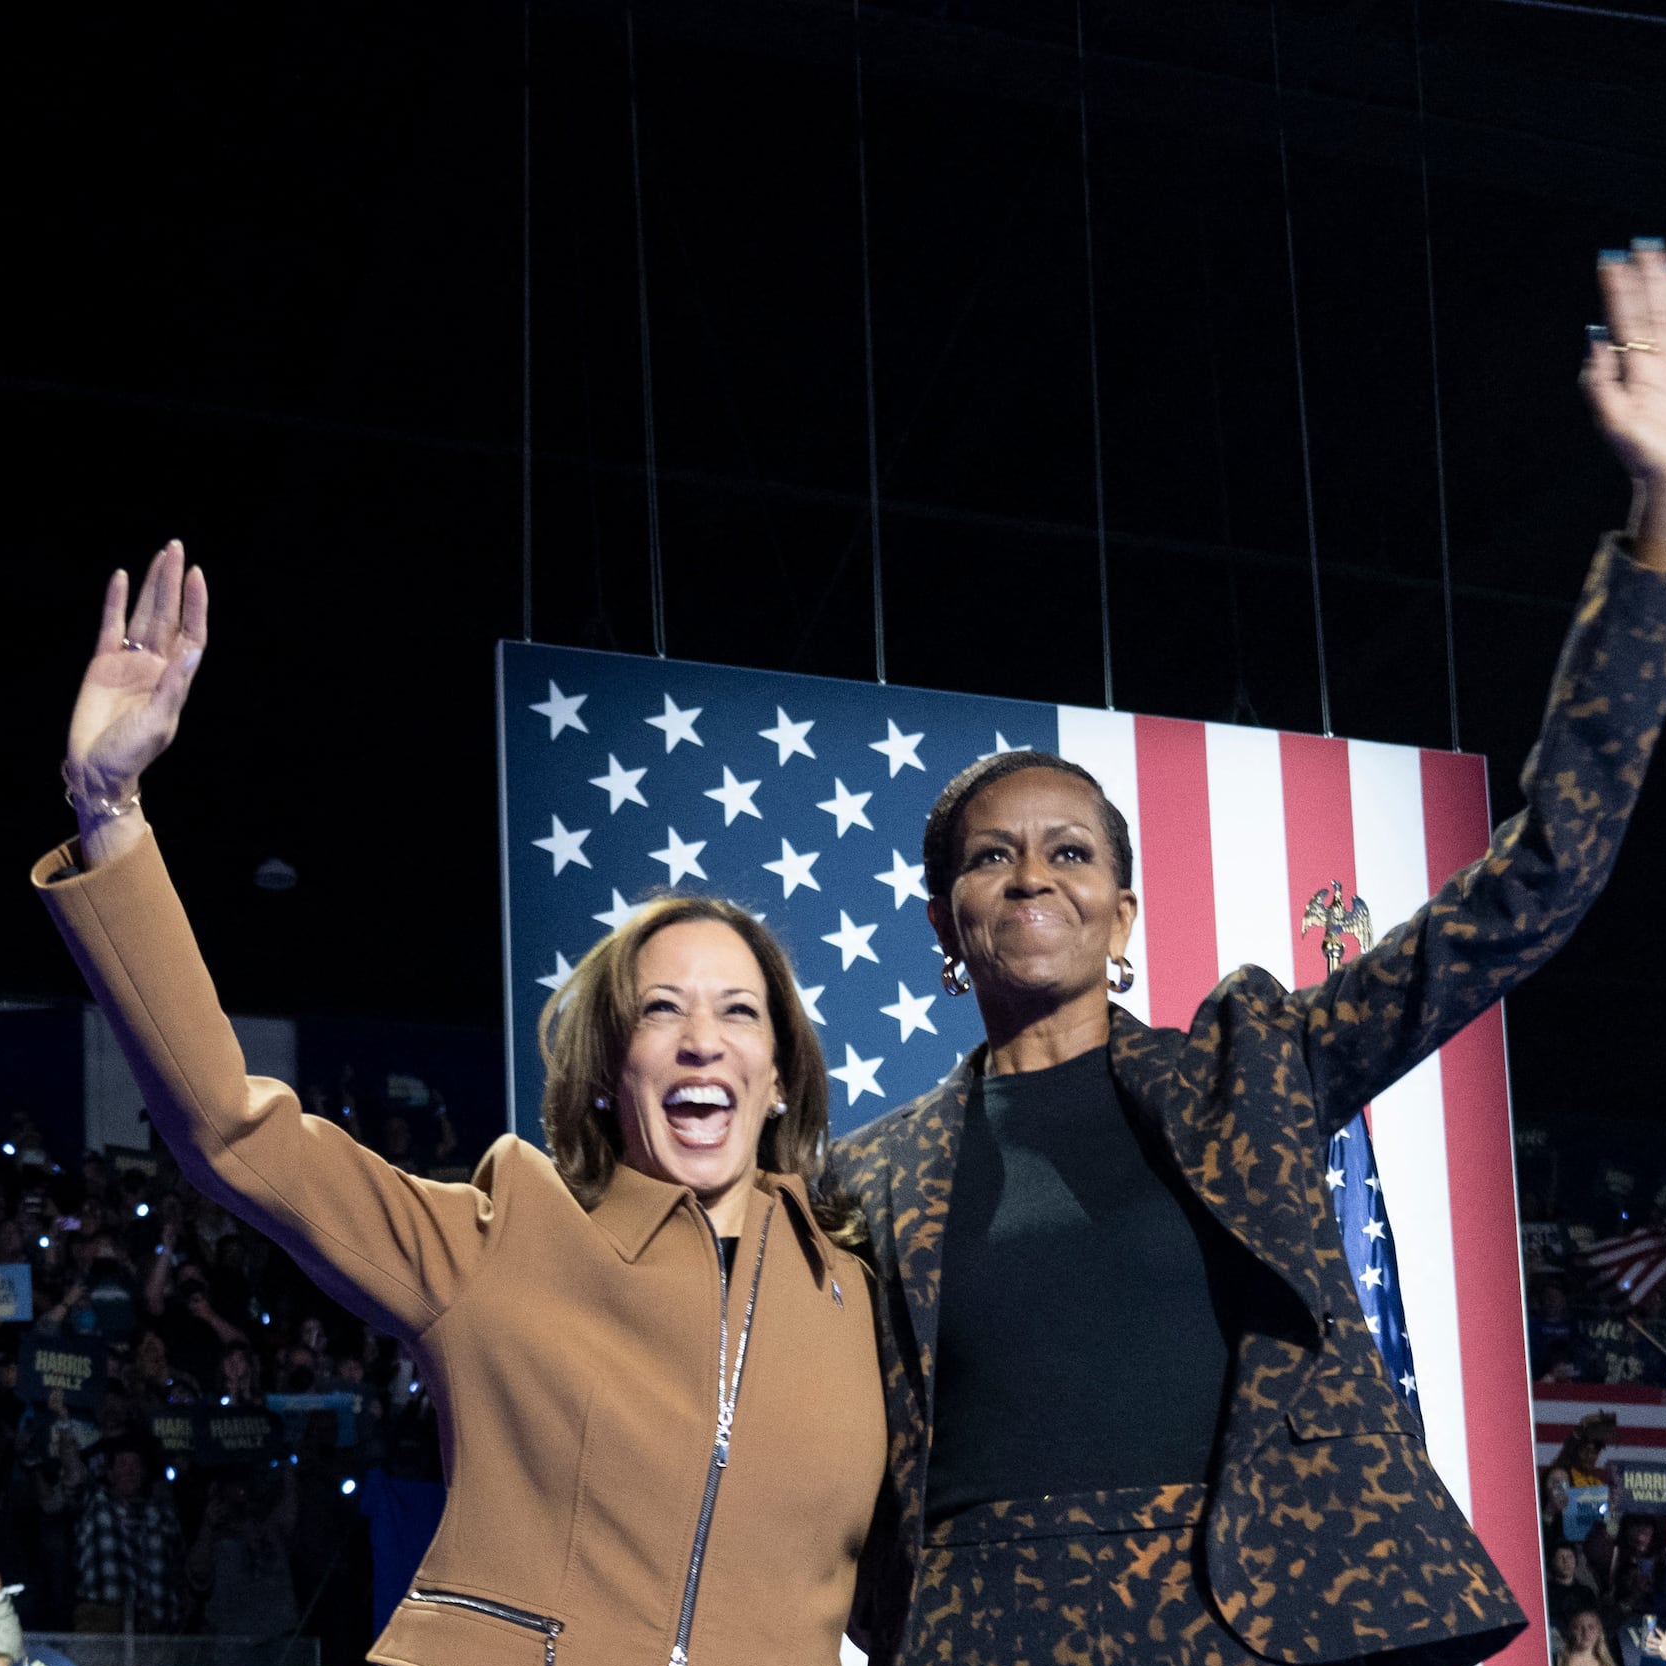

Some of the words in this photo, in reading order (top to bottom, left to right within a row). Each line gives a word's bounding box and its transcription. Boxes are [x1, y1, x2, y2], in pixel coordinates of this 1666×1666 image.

[35, 1349, 92, 1379] HARRIS
[42, 1374, 83, 1391] WALZ
[153, 1417, 194, 1438] HARR
[209, 1416, 272, 1439] HARRIS
[162, 1437, 194, 1450] WAL
